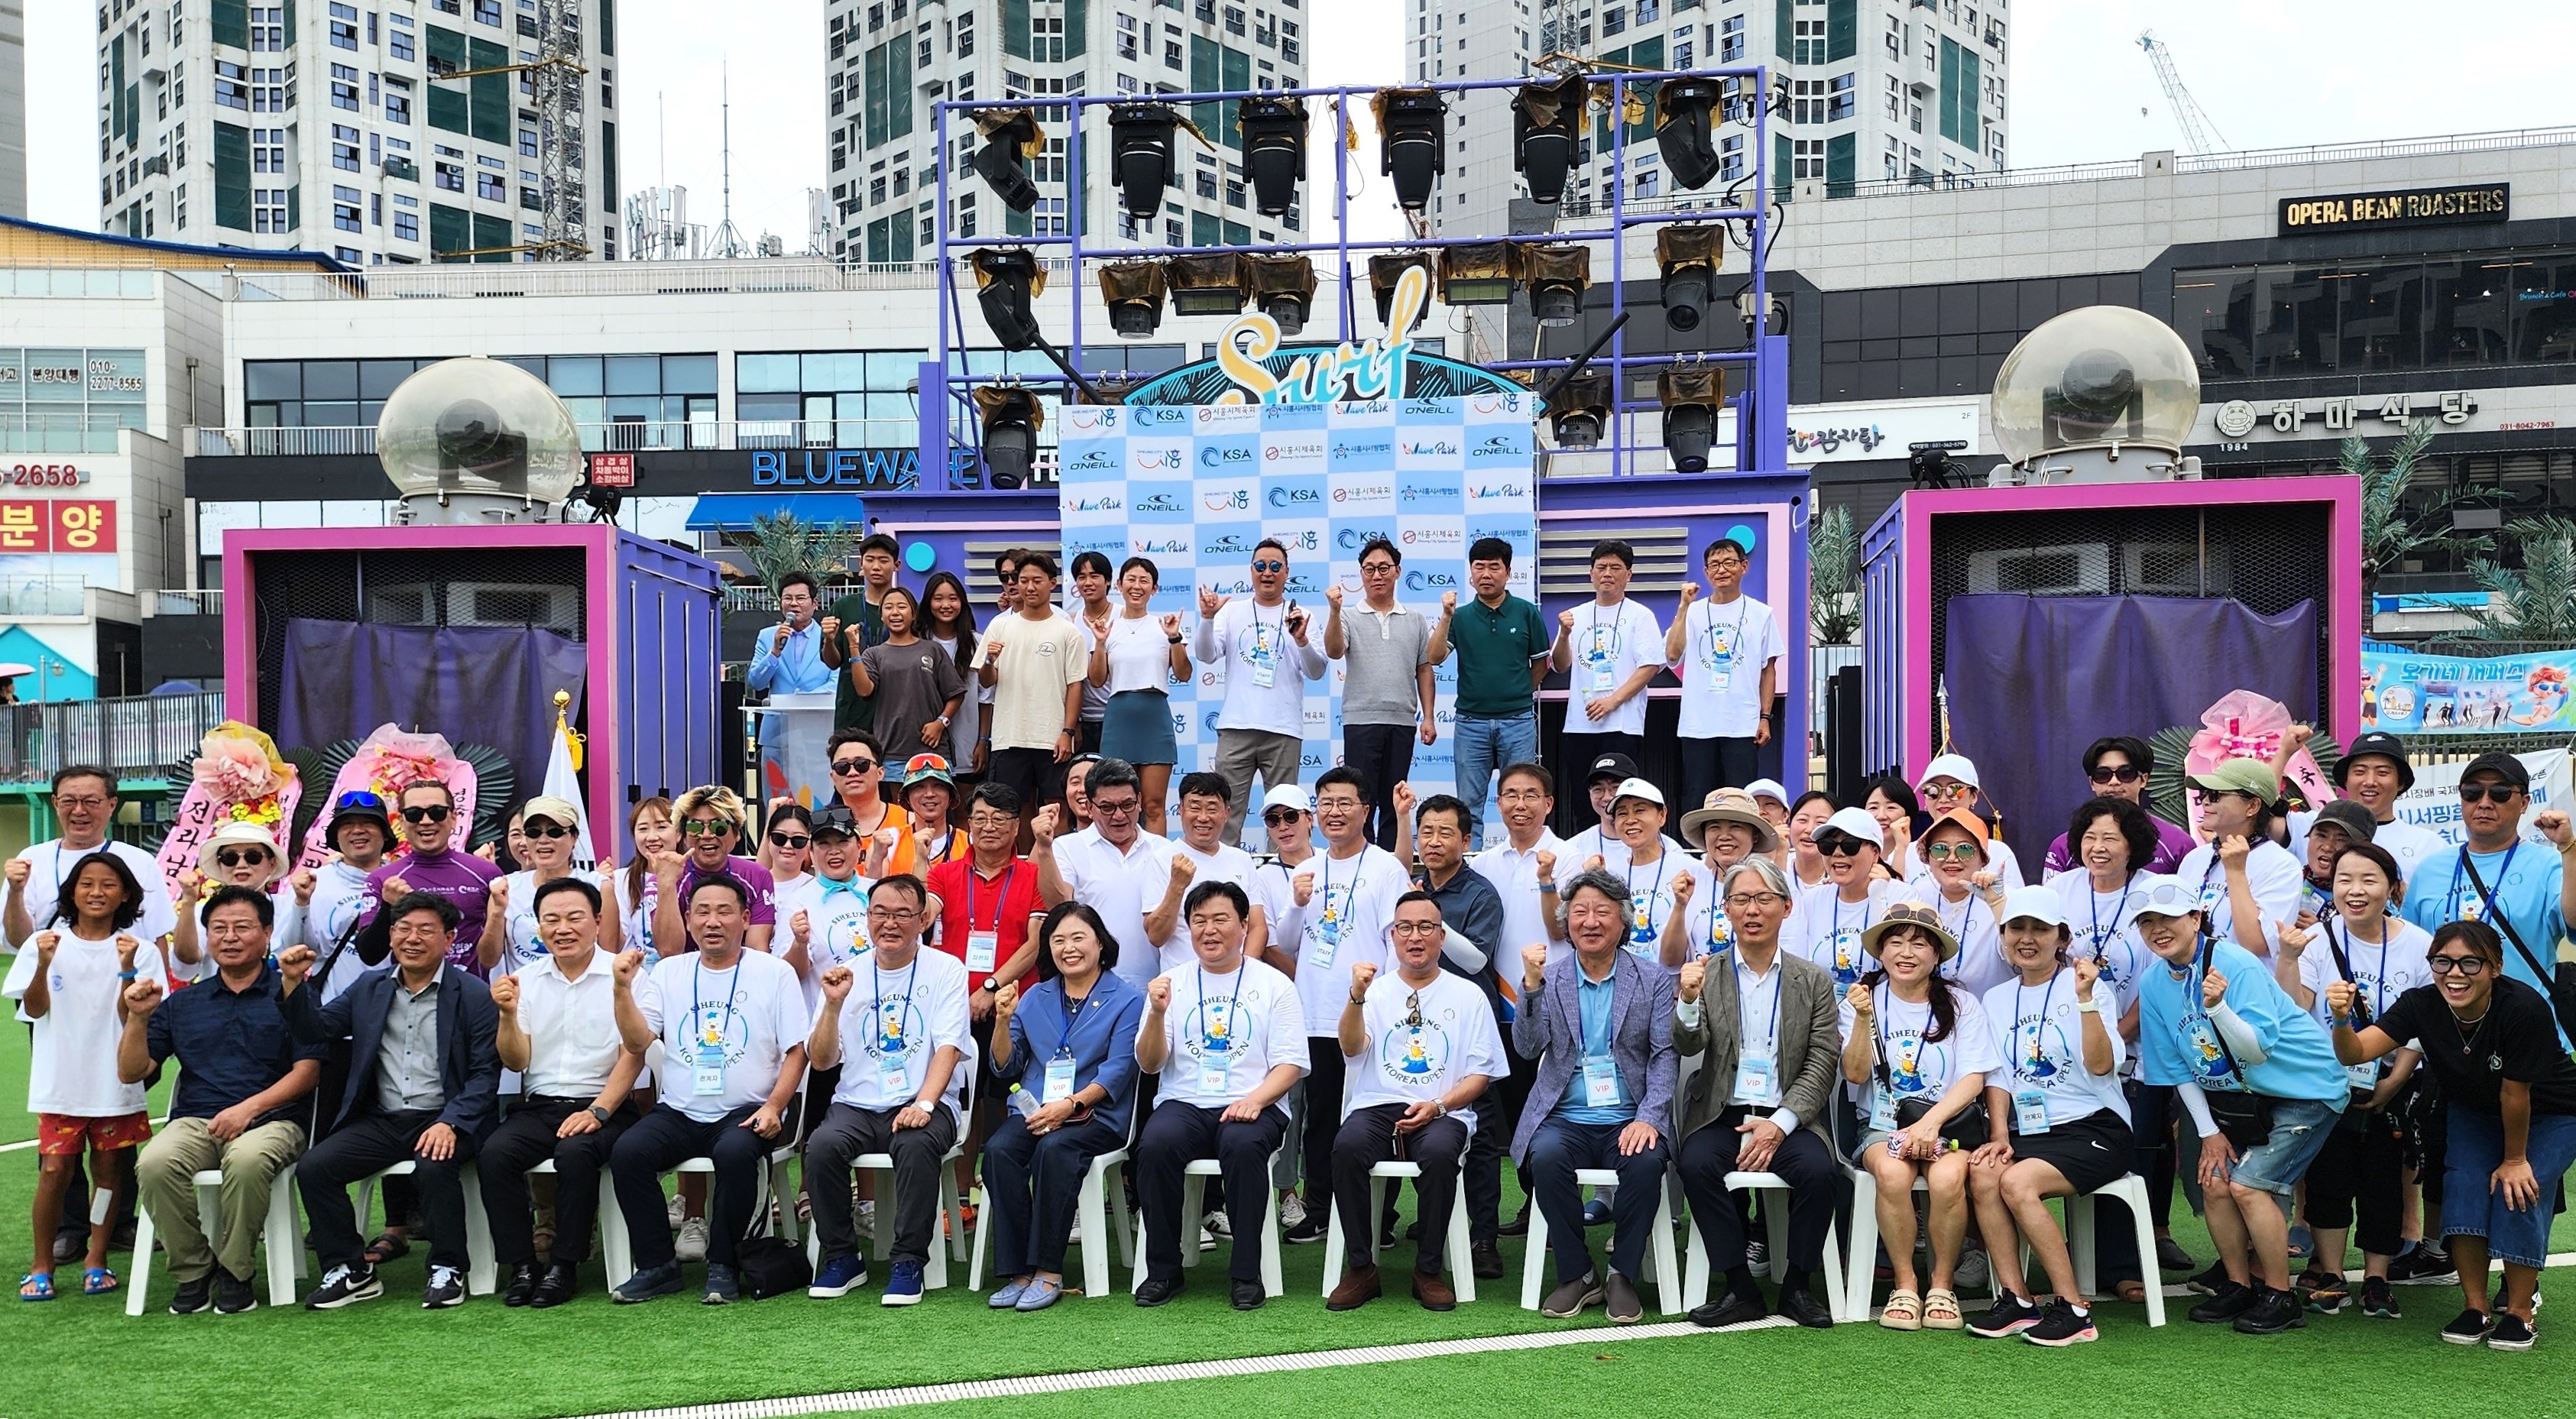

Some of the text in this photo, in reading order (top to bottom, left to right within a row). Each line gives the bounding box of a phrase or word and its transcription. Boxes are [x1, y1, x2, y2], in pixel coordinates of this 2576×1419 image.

[2287, 189, 2504, 226] OPERA BEAN ROASTERS
[1216, 264, 1427, 404] Surf
[32, 368, 79, 382] 분양대행
[91, 377, 143, 390] 2277-8565
[1213, 407, 1256, 416] 시흥시체육회
[1282, 404, 1323, 413] 시흥시서핑협회
[1335, 400, 1388, 415] Wave Park
[1156, 410, 1185, 420] KSA
[2499, 421, 2555, 430] 031-8042-7963
[1279, 445, 1323, 455] 시흥시체육회
[1350, 443, 1391, 452] 시흥시서핑협회
[1402, 442, 1457, 455] Wave Park
[2220, 442, 2248, 452] 1984
[1223, 449, 1252, 460] KSA
[595, 466, 630, 475] 차돌박이
[752, 449, 978, 485] BLUEWAE
[0, 464, 79, 487] -2658
[595, 475, 630, 484] 소갈비살
[1290, 489, 1320, 501] KSA
[1347, 487, 1391, 497] 시흥시체육회
[1469, 484, 1525, 499] Wave Park
[1068, 497, 1122, 511] Wave Park
[0, 504, 102, 548] 분양
[1359, 530, 1388, 543] KSA
[1418, 530, 1461, 539] 시흥시체육회
[1086, 541, 1125, 549] 시흥시서핑협회
[1135, 540, 1188, 553] Wave Park
[1427, 574, 1457, 585] KSA
[1158, 585, 1191, 593] 흥시서핑협회
[1234, 581, 1255, 594] Park
[1282, 585, 1320, 594] NEILL
[1421, 754, 1455, 763] 시흥시서핑협
[166, 799, 210, 886] 전라남
[831, 912, 869, 925] SIHEUN
[1823, 927, 1863, 941] SIHEUN
[2075, 924, 2124, 941] SIHEUNG
[1316, 947, 1331, 957] STAFF
[2352, 971, 2393, 993] HEUNG
[1383, 1062, 1446, 1085] KOREA OPEN
[2190, 1070, 2234, 1087] KOREA
[887, 1077, 902, 1085] VIP
[1594, 1084, 1609, 1093] VIP
[2024, 1112, 2043, 1121] 관계자
